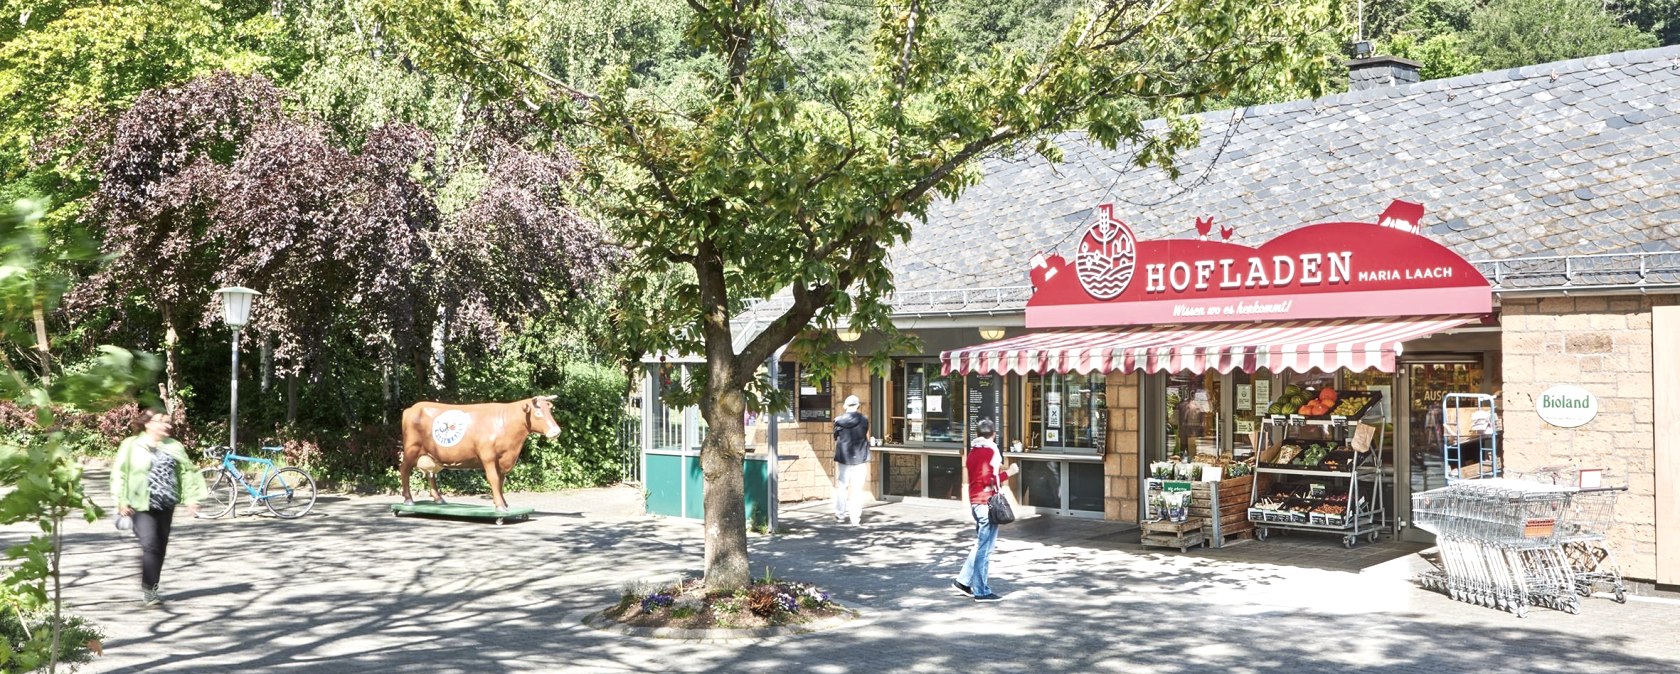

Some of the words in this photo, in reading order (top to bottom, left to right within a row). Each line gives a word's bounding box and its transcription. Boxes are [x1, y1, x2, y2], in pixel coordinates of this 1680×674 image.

[1146, 252, 1352, 292] HOFLADEN
[1358, 271, 1401, 282] MARIA
[1405, 267, 1452, 279] LAACH
[1173, 304, 1205, 317] Wissen
[1207, 305, 1221, 315] wo
[1223, 304, 1235, 315] es
[1236, 300, 1292, 315] herkommt!
[1542, 394, 1591, 409] Bioland
